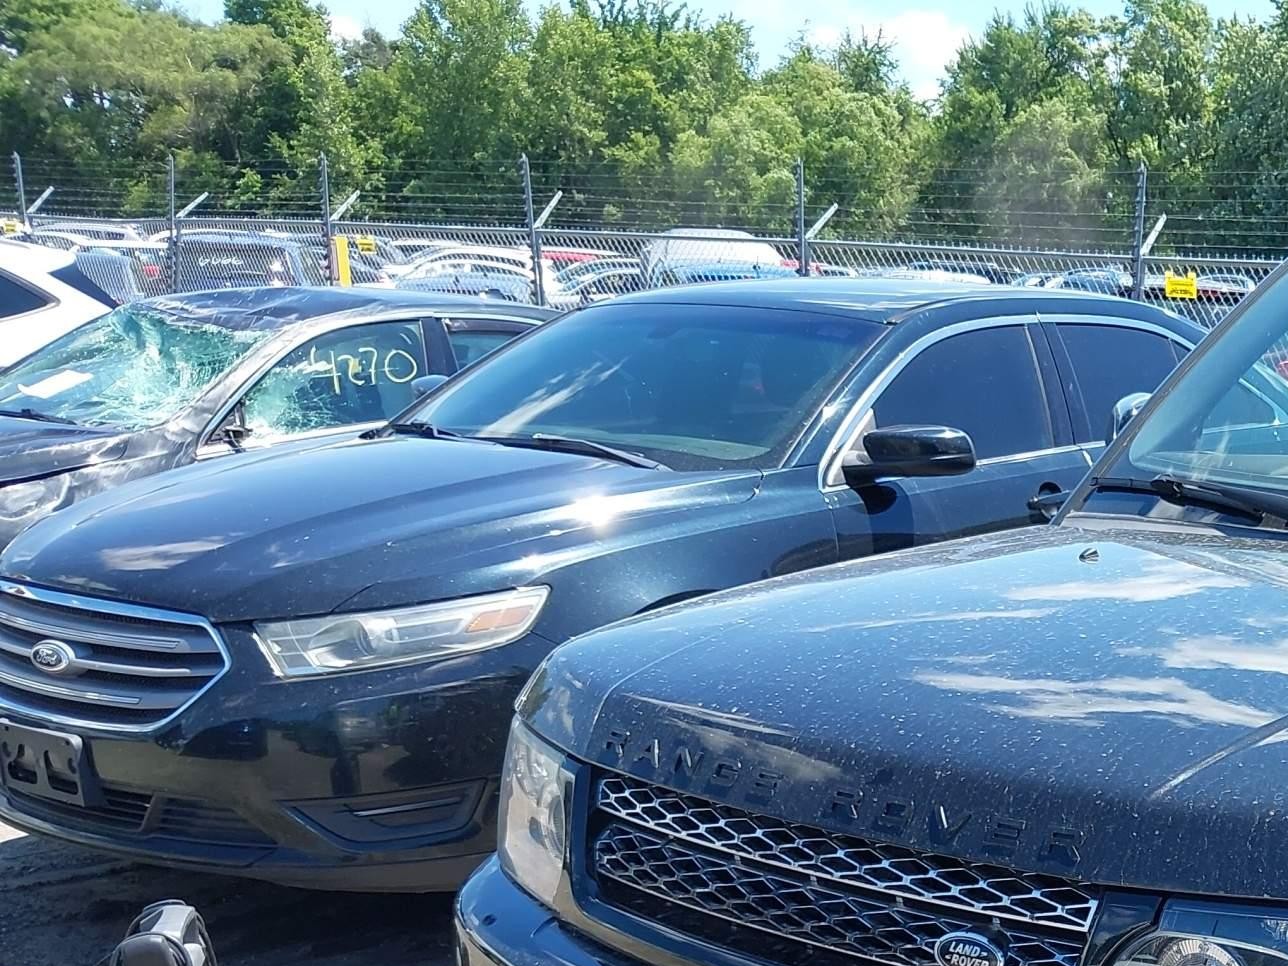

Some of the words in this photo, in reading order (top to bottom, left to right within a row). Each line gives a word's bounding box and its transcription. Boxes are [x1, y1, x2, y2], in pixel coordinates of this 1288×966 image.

[304, 345, 418, 395] 4270
[36, 648, 58, 665] Ford
[605, 729, 785, 796] RANGE
[832, 788, 1088, 864] ROVER
[948, 941, 981, 957] LAND
